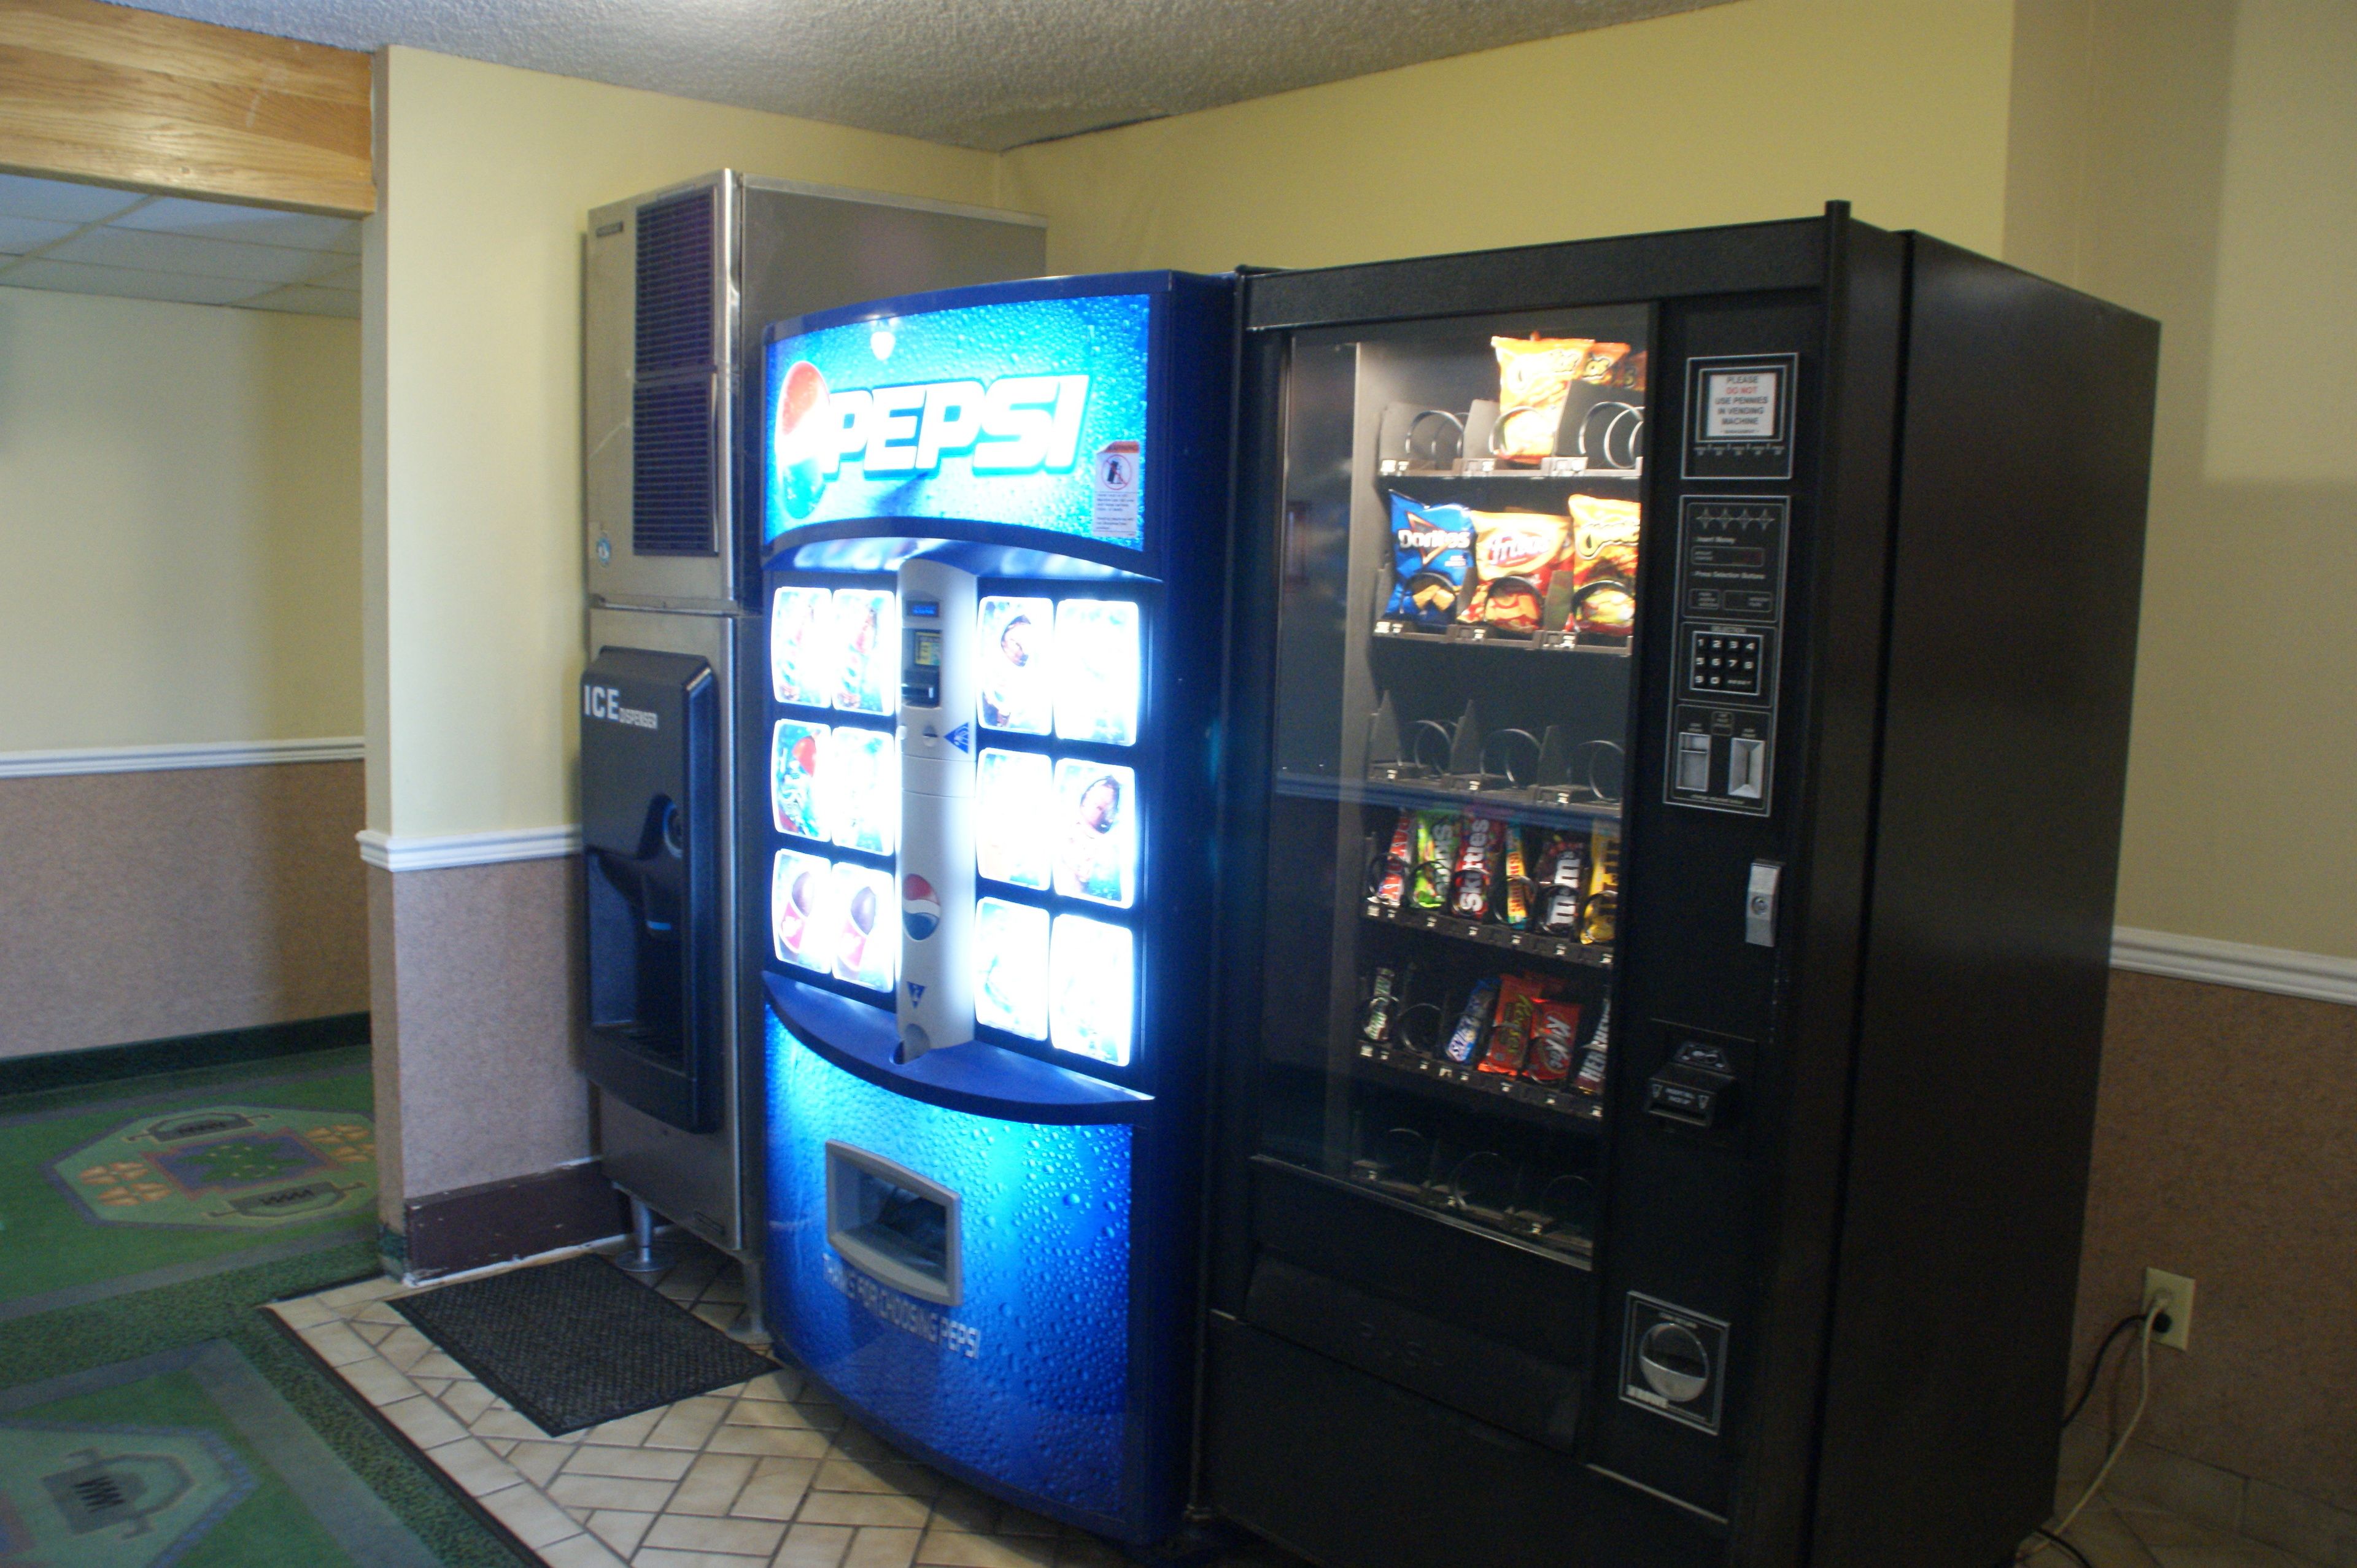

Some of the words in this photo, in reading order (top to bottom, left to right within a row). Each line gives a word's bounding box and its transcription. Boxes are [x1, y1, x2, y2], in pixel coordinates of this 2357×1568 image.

[1726, 376, 1759, 384] PLEASE
[1733, 396, 1768, 404] PENNIES
[1728, 406, 1765, 415] VENDING
[822, 374, 1090, 481] PEPSI
[1398, 529, 1471, 549] Doritos
[1697, 638, 1705, 647] 1
[1712, 639, 1722, 648] 2
[1728, 641, 1739, 649] 3
[1695, 657, 1705, 665] 5
[1728, 659, 1738, 668] 7
[1744, 661, 1754, 670] 8
[1694, 675, 1705, 684] 9
[1709, 676, 1720, 685] 0
[584, 684, 620, 721] ICE
[1460, 818, 1490, 913] Skittles
